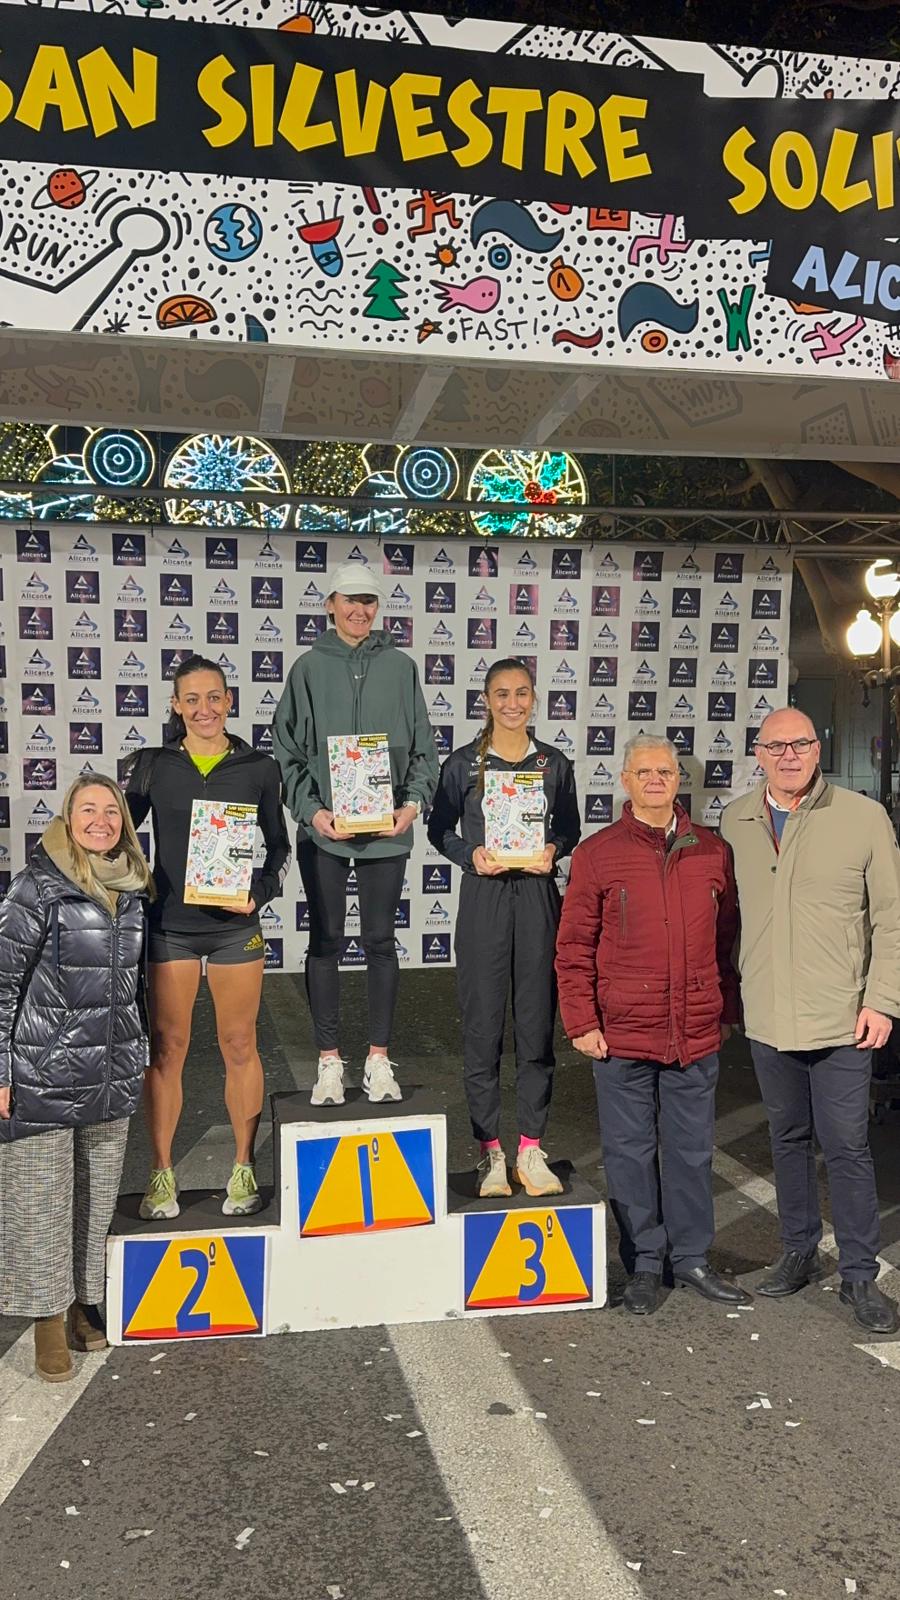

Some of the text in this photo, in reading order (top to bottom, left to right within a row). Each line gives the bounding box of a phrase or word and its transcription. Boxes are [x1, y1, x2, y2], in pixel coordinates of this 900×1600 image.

[0, 46, 900, 214] AN SILVESTRE SOLI
[3, 223, 72, 268] RUN
[792, 245, 900, 311] ALIC
[176, 1241, 216, 1333] 2º
[518, 1214, 554, 1302] 3º
